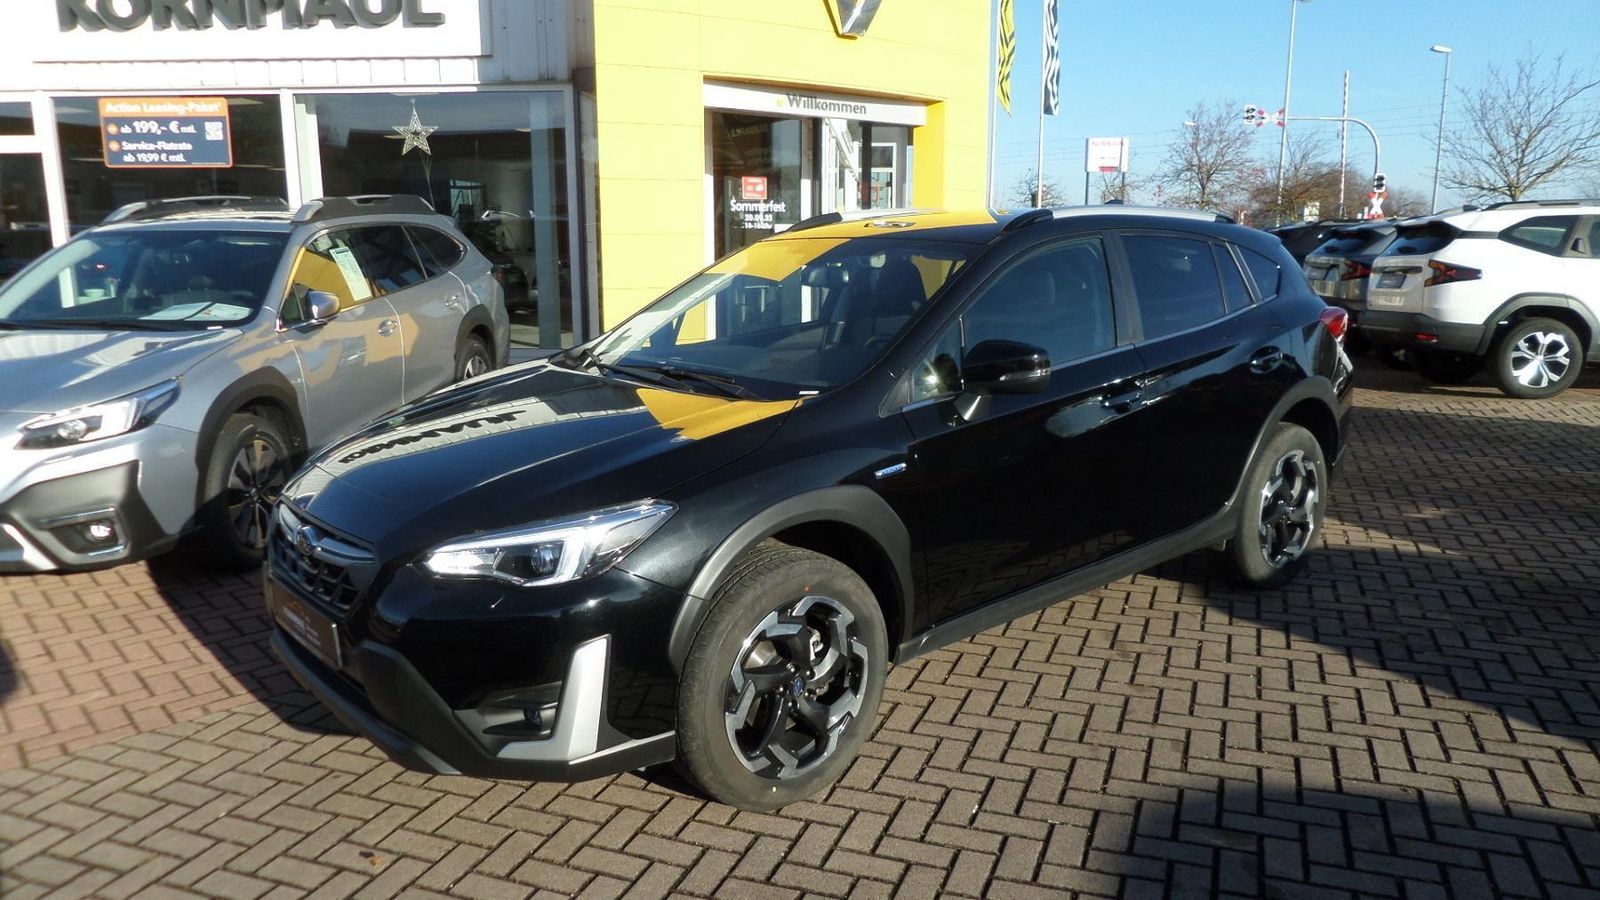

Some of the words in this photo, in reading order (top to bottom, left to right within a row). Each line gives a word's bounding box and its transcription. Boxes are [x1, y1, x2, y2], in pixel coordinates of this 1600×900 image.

[58, 0, 446, 32] KORNMAUL
[105, 102, 139, 113] Action
[786, 93, 867, 114] Willkommen
[120, 124, 132, 133] ab
[169, 120, 180, 133] €
[121, 140, 193, 151] Service-Flatrate
[123, 153, 135, 162] ab
[136, 153, 159, 163] 19,99
[160, 153, 168, 162] €
[730, 199, 786, 212] Sommerfest
